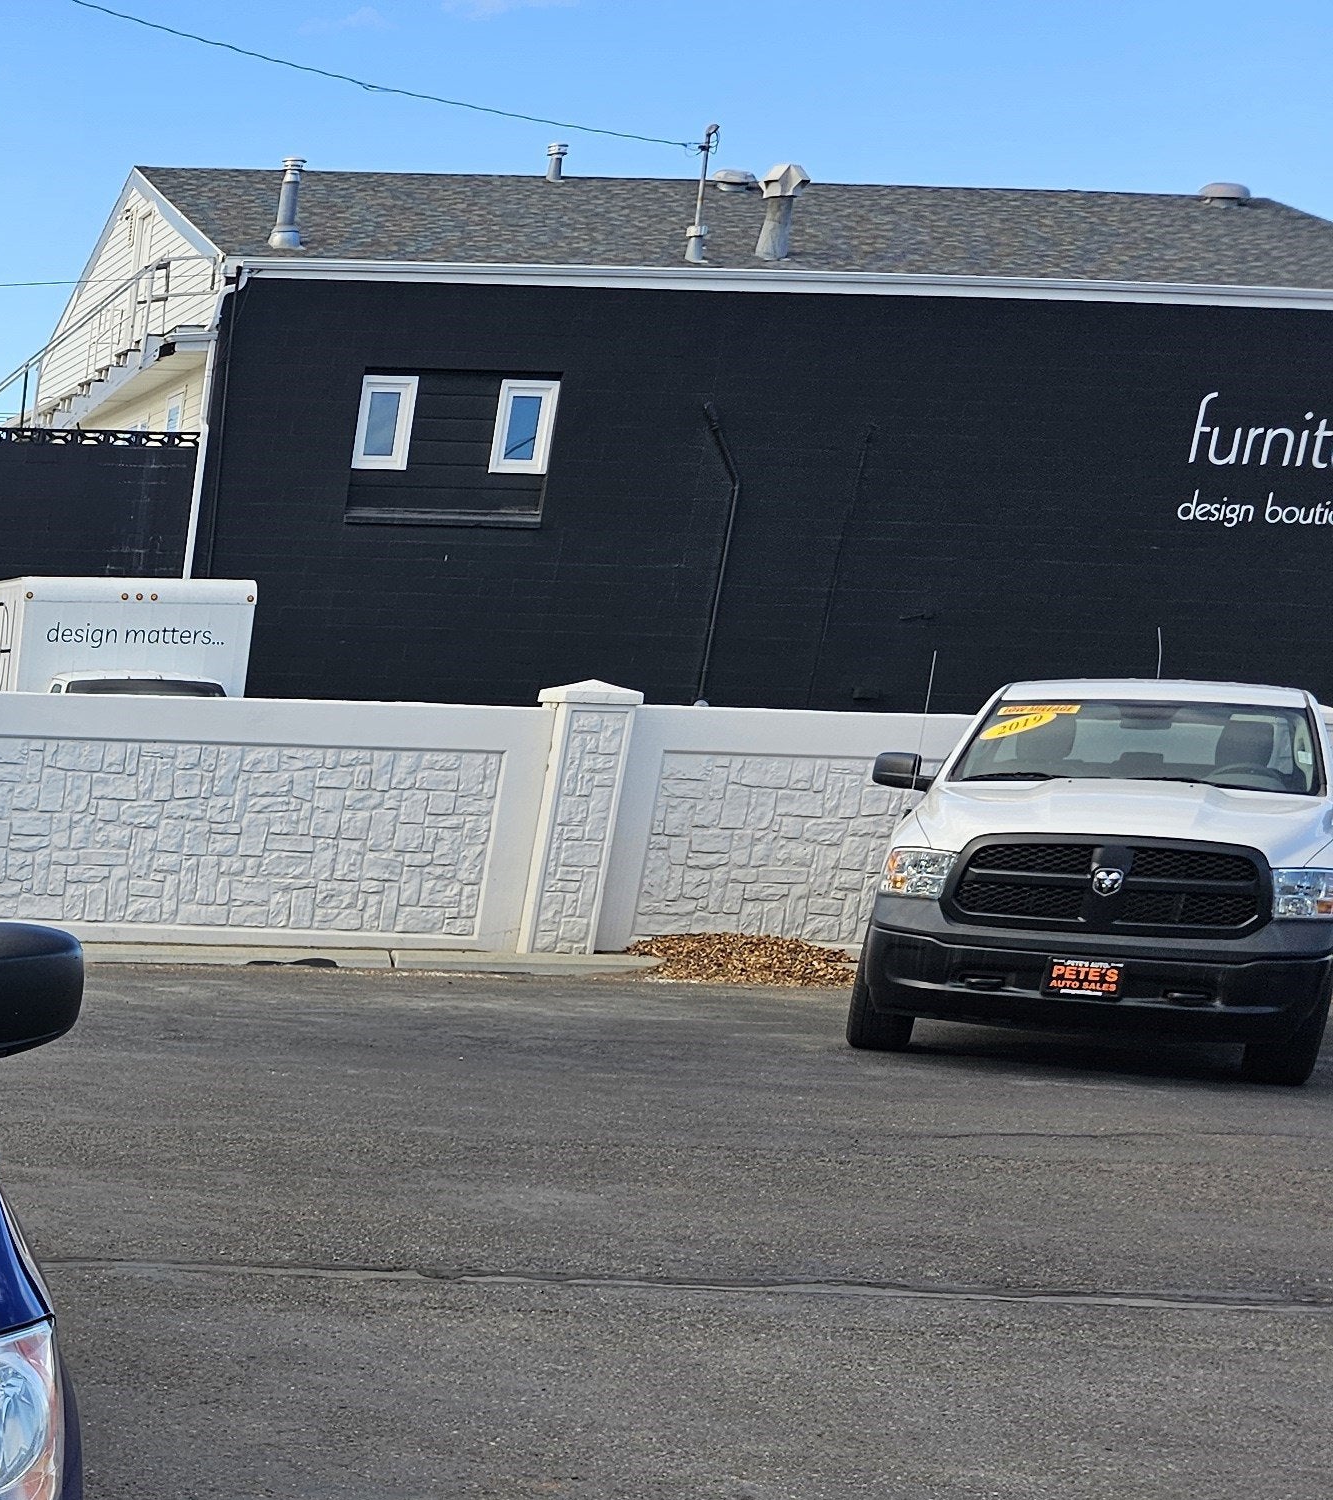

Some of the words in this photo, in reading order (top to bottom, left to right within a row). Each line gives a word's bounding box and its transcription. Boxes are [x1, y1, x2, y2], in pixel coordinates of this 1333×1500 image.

[1188, 392, 1333, 468] furnit
[1177, 489, 1254, 527] design
[46, 622, 117, 648] design
[125, 627, 224, 645] matters...
[998, 715, 1043, 735] 2019
[1052, 965, 1118, 981] PETE'S
[1049, 980, 1079, 988] AUTO
[1082, 982, 1116, 991] SALES
